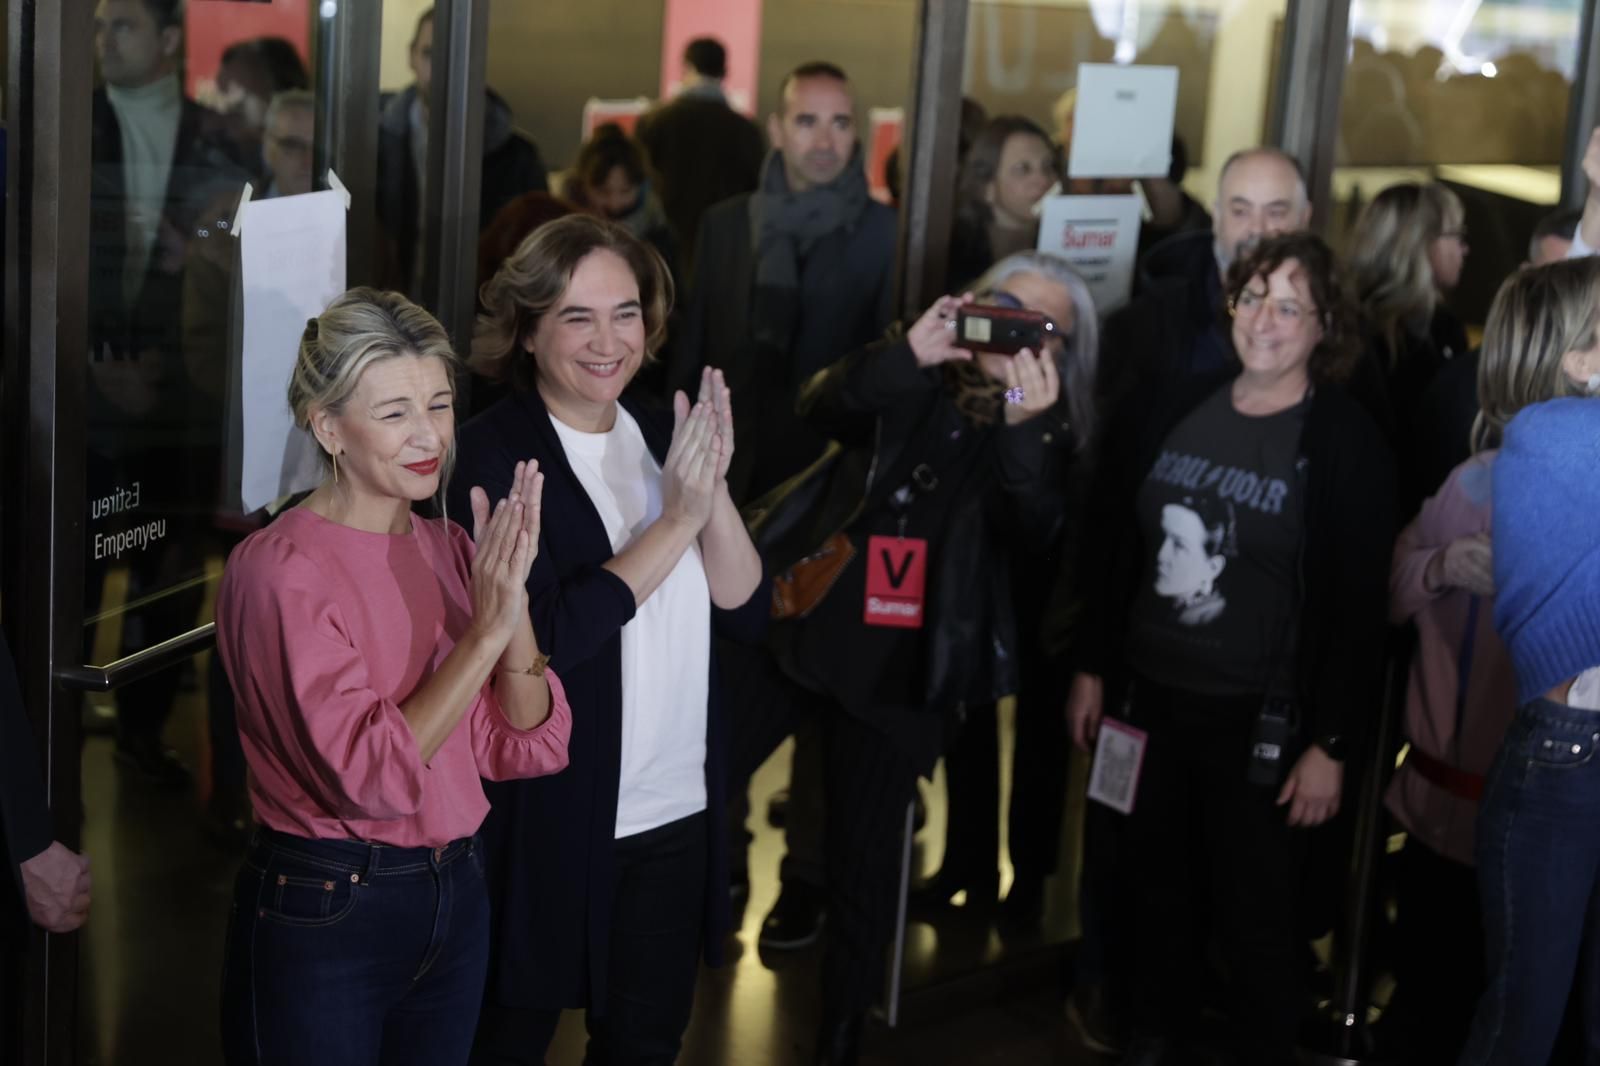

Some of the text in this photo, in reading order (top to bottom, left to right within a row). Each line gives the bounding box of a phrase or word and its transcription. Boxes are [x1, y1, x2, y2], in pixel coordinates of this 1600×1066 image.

[1063, 224, 1117, 250] Sumar
[94, 519, 166, 560] Empenyeu
[881, 547, 915, 589] V
[867, 596, 920, 616] Sumar
